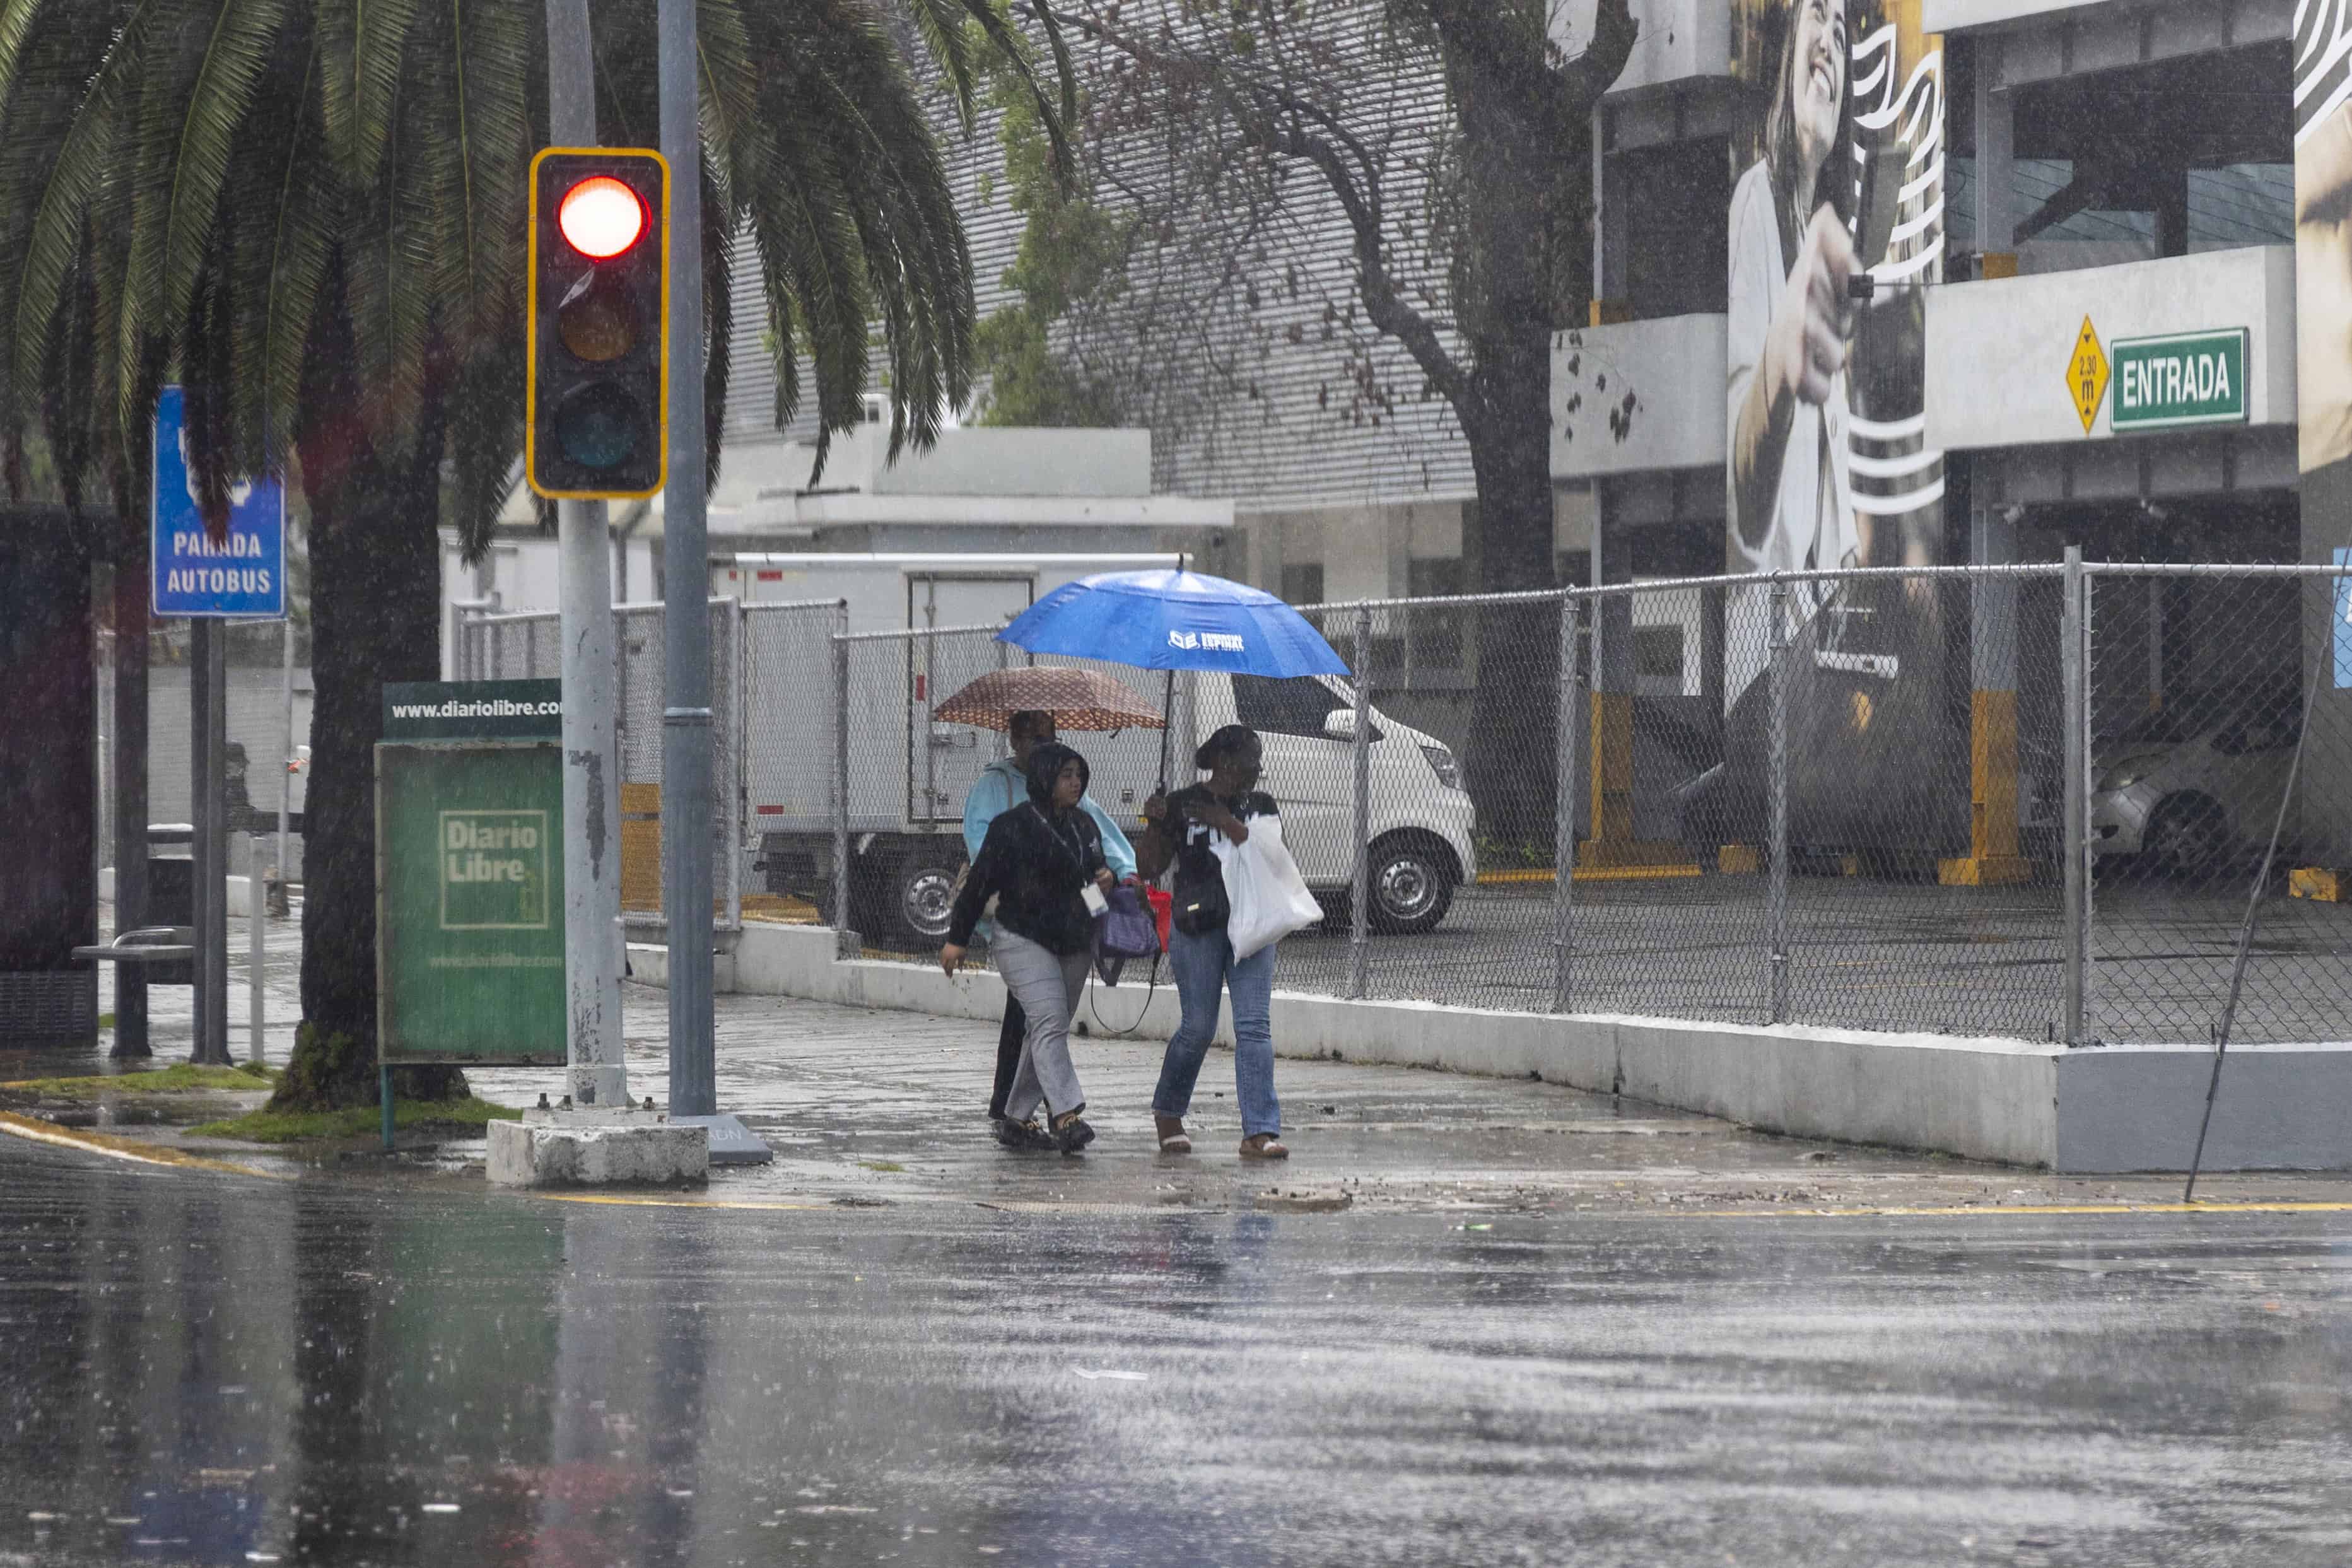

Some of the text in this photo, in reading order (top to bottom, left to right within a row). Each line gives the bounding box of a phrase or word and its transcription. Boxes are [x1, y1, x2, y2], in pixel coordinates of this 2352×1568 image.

[2079, 355, 2097, 376] 2.30
[2082, 379, 2094, 402] m
[2123, 352, 2231, 408] ENTRADA
[167, 567, 271, 594] AUTOBUS
[392, 699, 562, 718] www.diariolibre.co
[447, 820, 537, 849] Diario
[448, 853, 525, 882] Libre
